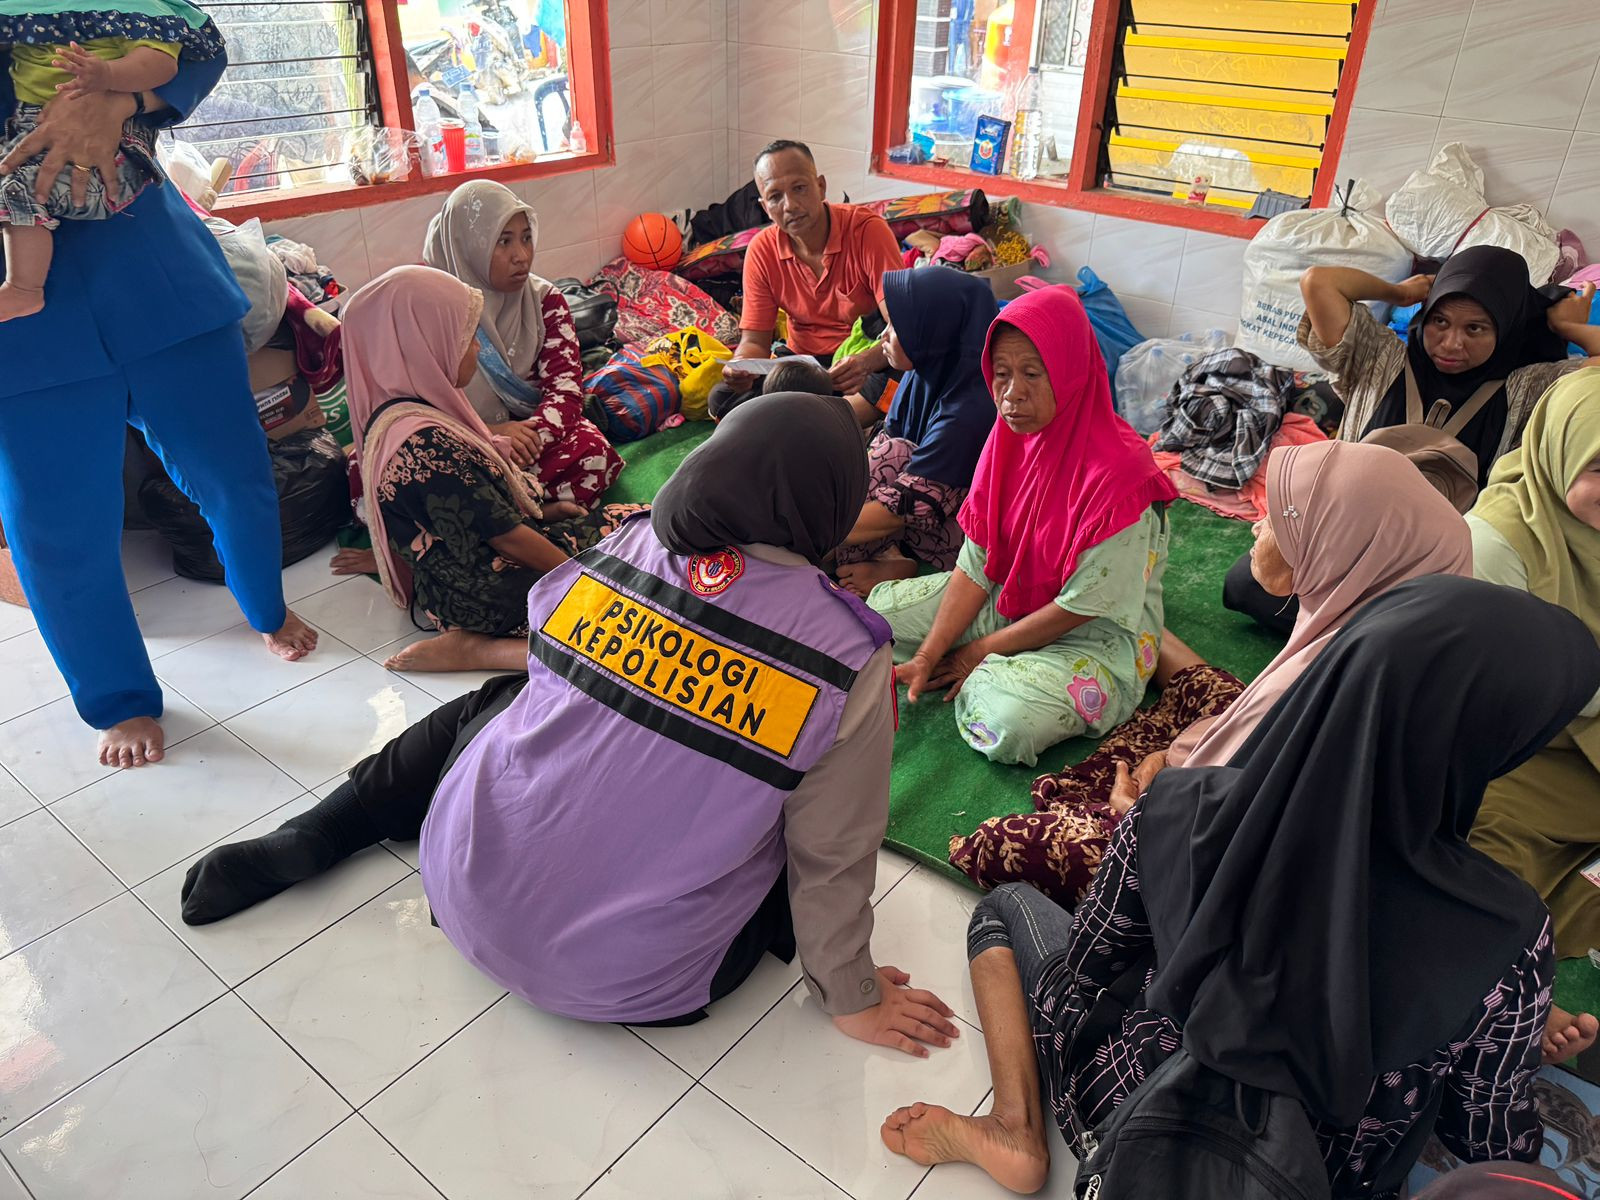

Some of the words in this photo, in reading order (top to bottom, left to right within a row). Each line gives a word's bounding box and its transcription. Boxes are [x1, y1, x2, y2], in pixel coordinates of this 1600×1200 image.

[1256, 300, 1283, 316] BERAS
[1284, 310, 1301, 321] PUT
[1255, 314, 1277, 327] ASAL
[1278, 321, 1298, 333] INDI
[1262, 328, 1299, 346] KEPEGA
[601, 600, 759, 694] PSIKOLOGI
[568, 616, 766, 736] KEPOLISIAN
